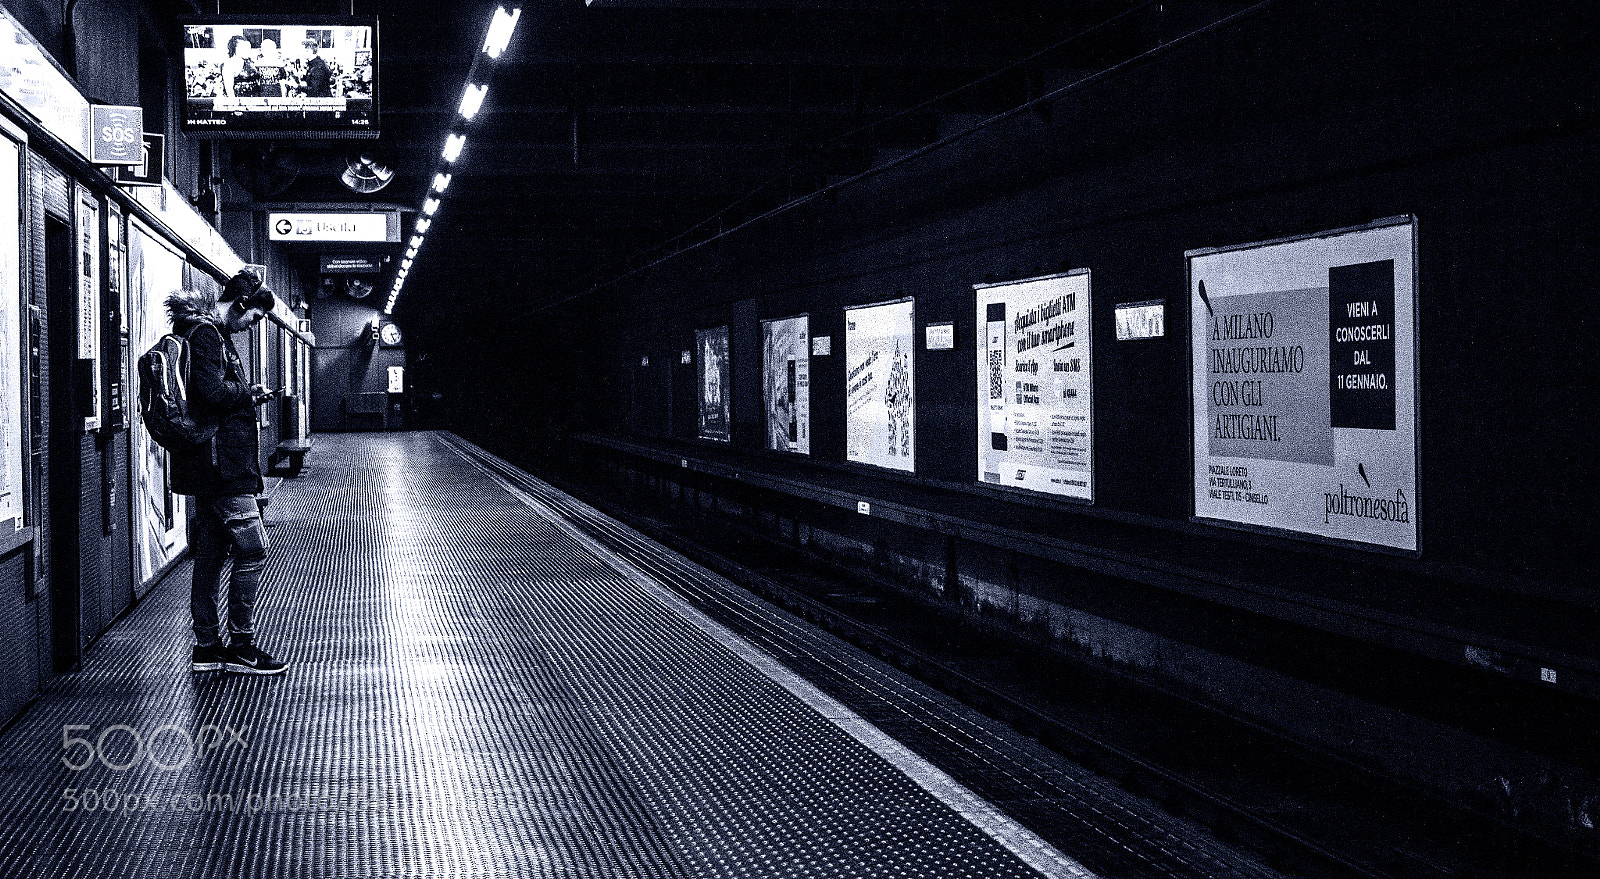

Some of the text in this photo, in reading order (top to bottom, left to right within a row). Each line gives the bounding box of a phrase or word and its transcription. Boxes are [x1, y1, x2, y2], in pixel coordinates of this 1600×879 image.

[102, 126, 135, 144] SOS
[1041, 296, 1062, 326] biglietti
[1063, 292, 1076, 314] ATM
[1346, 300, 1379, 318] VIENI A
[1041, 320, 1075, 346] smartphone
[1212, 311, 1275, 341] A MILANO
[1335, 325, 1391, 342] CONOSCERLI
[1070, 358, 1081, 373] SMS
[1212, 345, 1304, 374] INAUGURIAMO
[1353, 349, 1371, 366] DAL
[1337, 373, 1388, 390] 11 GENNAIO.
[1213, 380, 1263, 407] CON GLI
[1214, 413, 1281, 442] ARTIGIANI.
[1230, 466, 1248, 477] LORETO
[1324, 484, 1410, 524] poltronesofà
